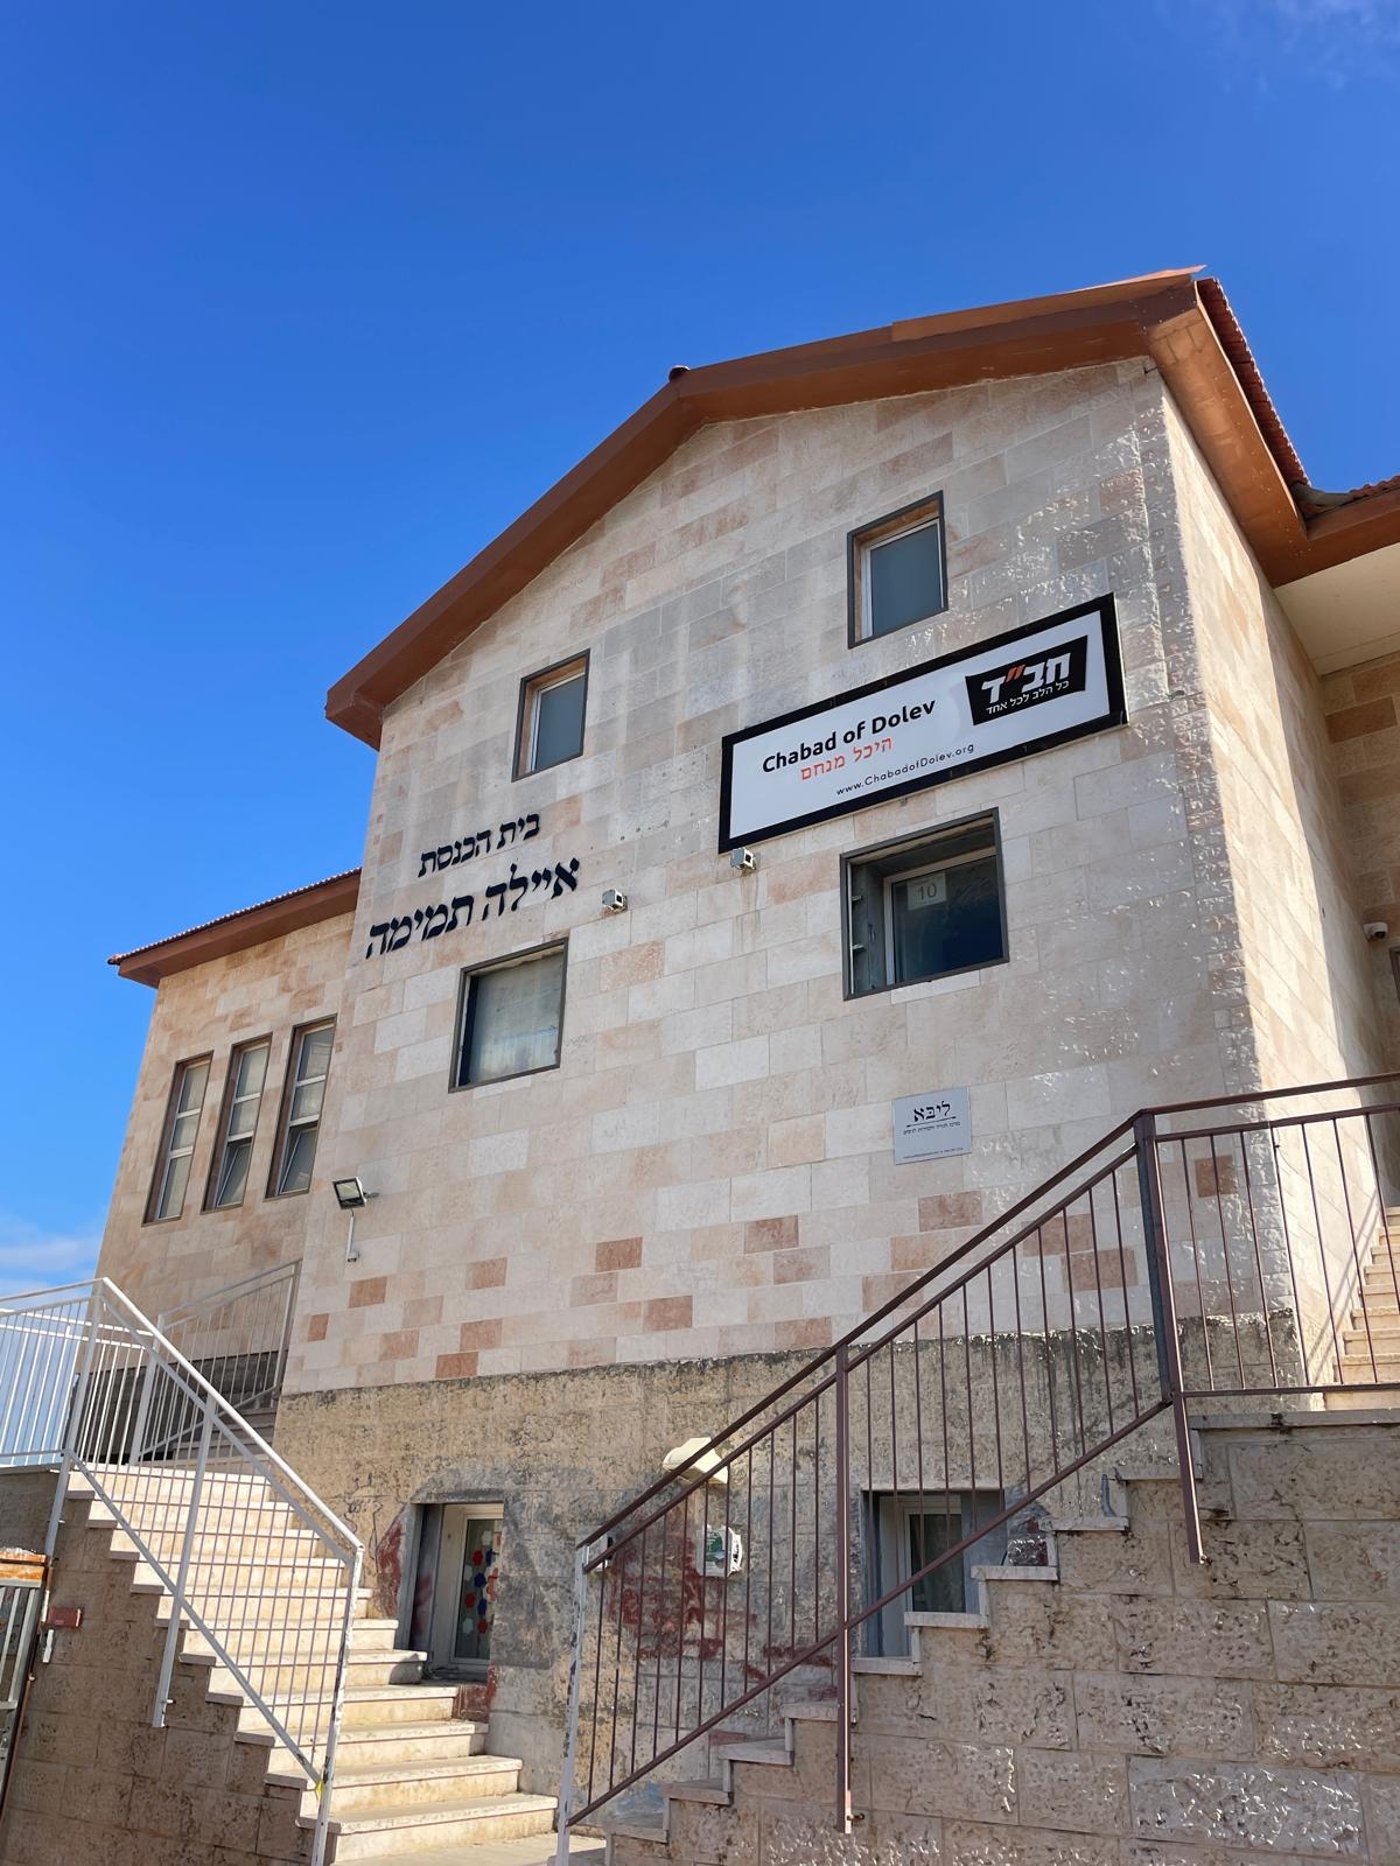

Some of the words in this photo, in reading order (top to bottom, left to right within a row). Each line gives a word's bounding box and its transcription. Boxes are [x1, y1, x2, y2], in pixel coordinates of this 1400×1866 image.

[1031, 686, 1054, 700] הלב
[1055, 680, 1070, 691] כל
[985, 701, 1008, 715] אחד
[1009, 693, 1030, 707] לכל
[762, 731, 837, 773] Chabad
[843, 720, 866, 744] of
[871, 700, 936, 735] Dolev
[852, 736, 893, 762] היכל
[800, 754, 846, 781] מנחם
[836, 743, 975, 796] www.ChabadofDolev.org
[496, 812, 540, 850] בית
[418, 829, 492, 878] הכנסת
[482, 857, 580, 921] איילה
[917, 882, 938, 900] 10
[365, 894, 475, 959] תמימה
